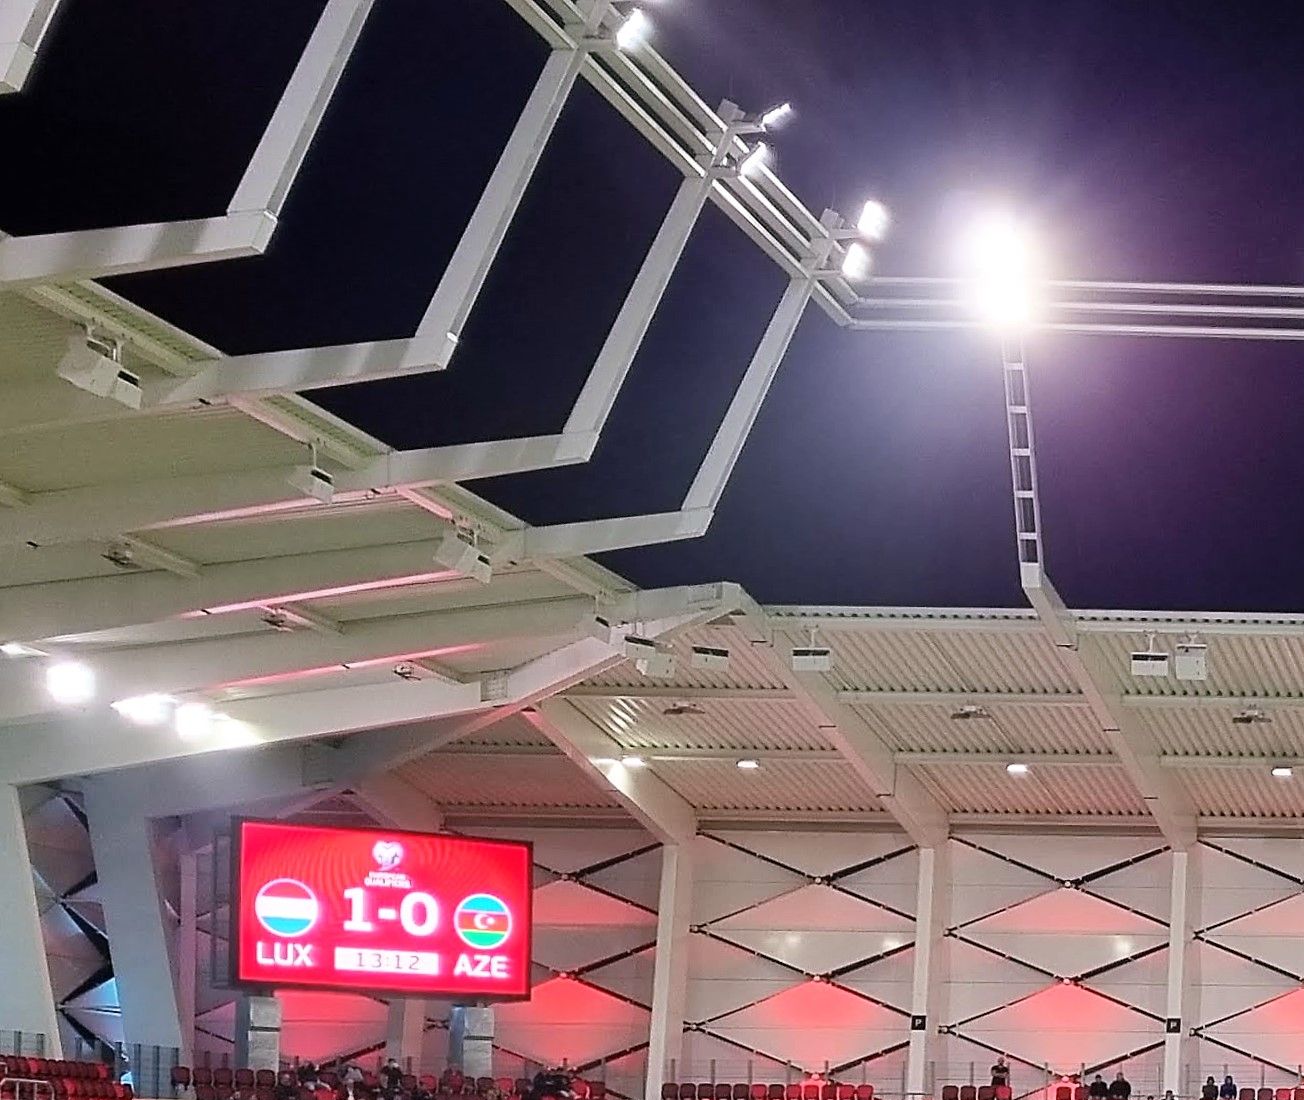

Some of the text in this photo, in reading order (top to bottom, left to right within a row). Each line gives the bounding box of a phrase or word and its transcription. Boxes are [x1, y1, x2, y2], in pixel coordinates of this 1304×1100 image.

[342, 887, 440, 937] 1-0
[256, 941, 314, 968] LUX
[356, 951, 420, 971] 13:12
[454, 955, 510, 979] AZE
